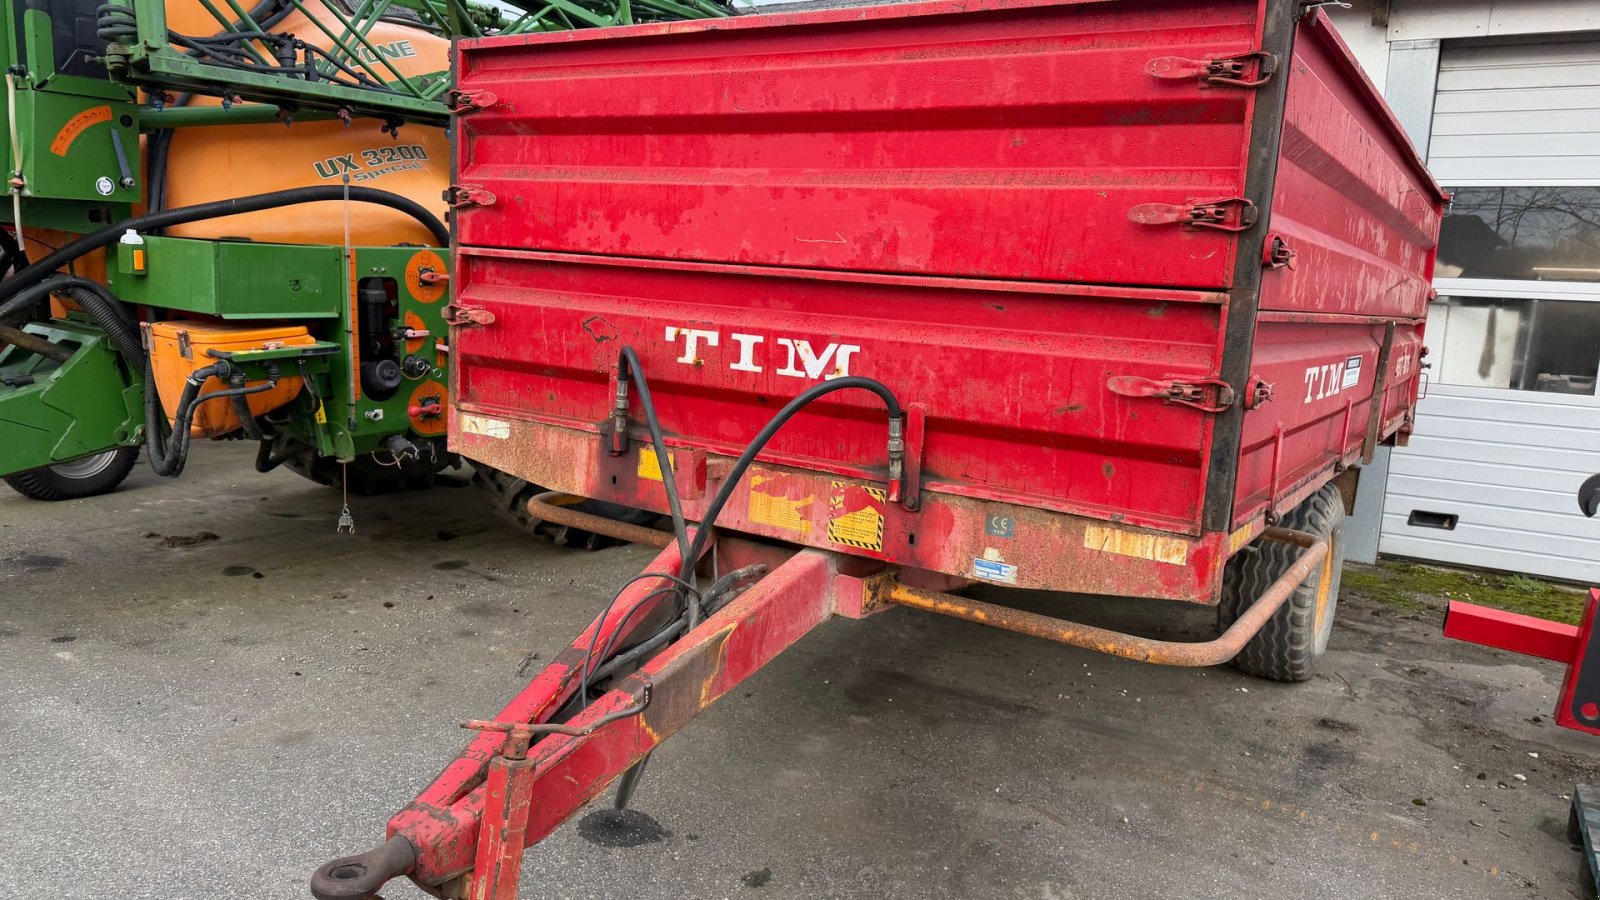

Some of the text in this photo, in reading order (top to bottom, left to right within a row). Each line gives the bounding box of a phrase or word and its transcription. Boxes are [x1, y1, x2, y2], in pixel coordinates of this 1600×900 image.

[313, 144, 430, 179] UX 3200
[353, 162, 424, 182] Special
[665, 326, 861, 381] TIM
[1304, 362, 1344, 404] TIM
